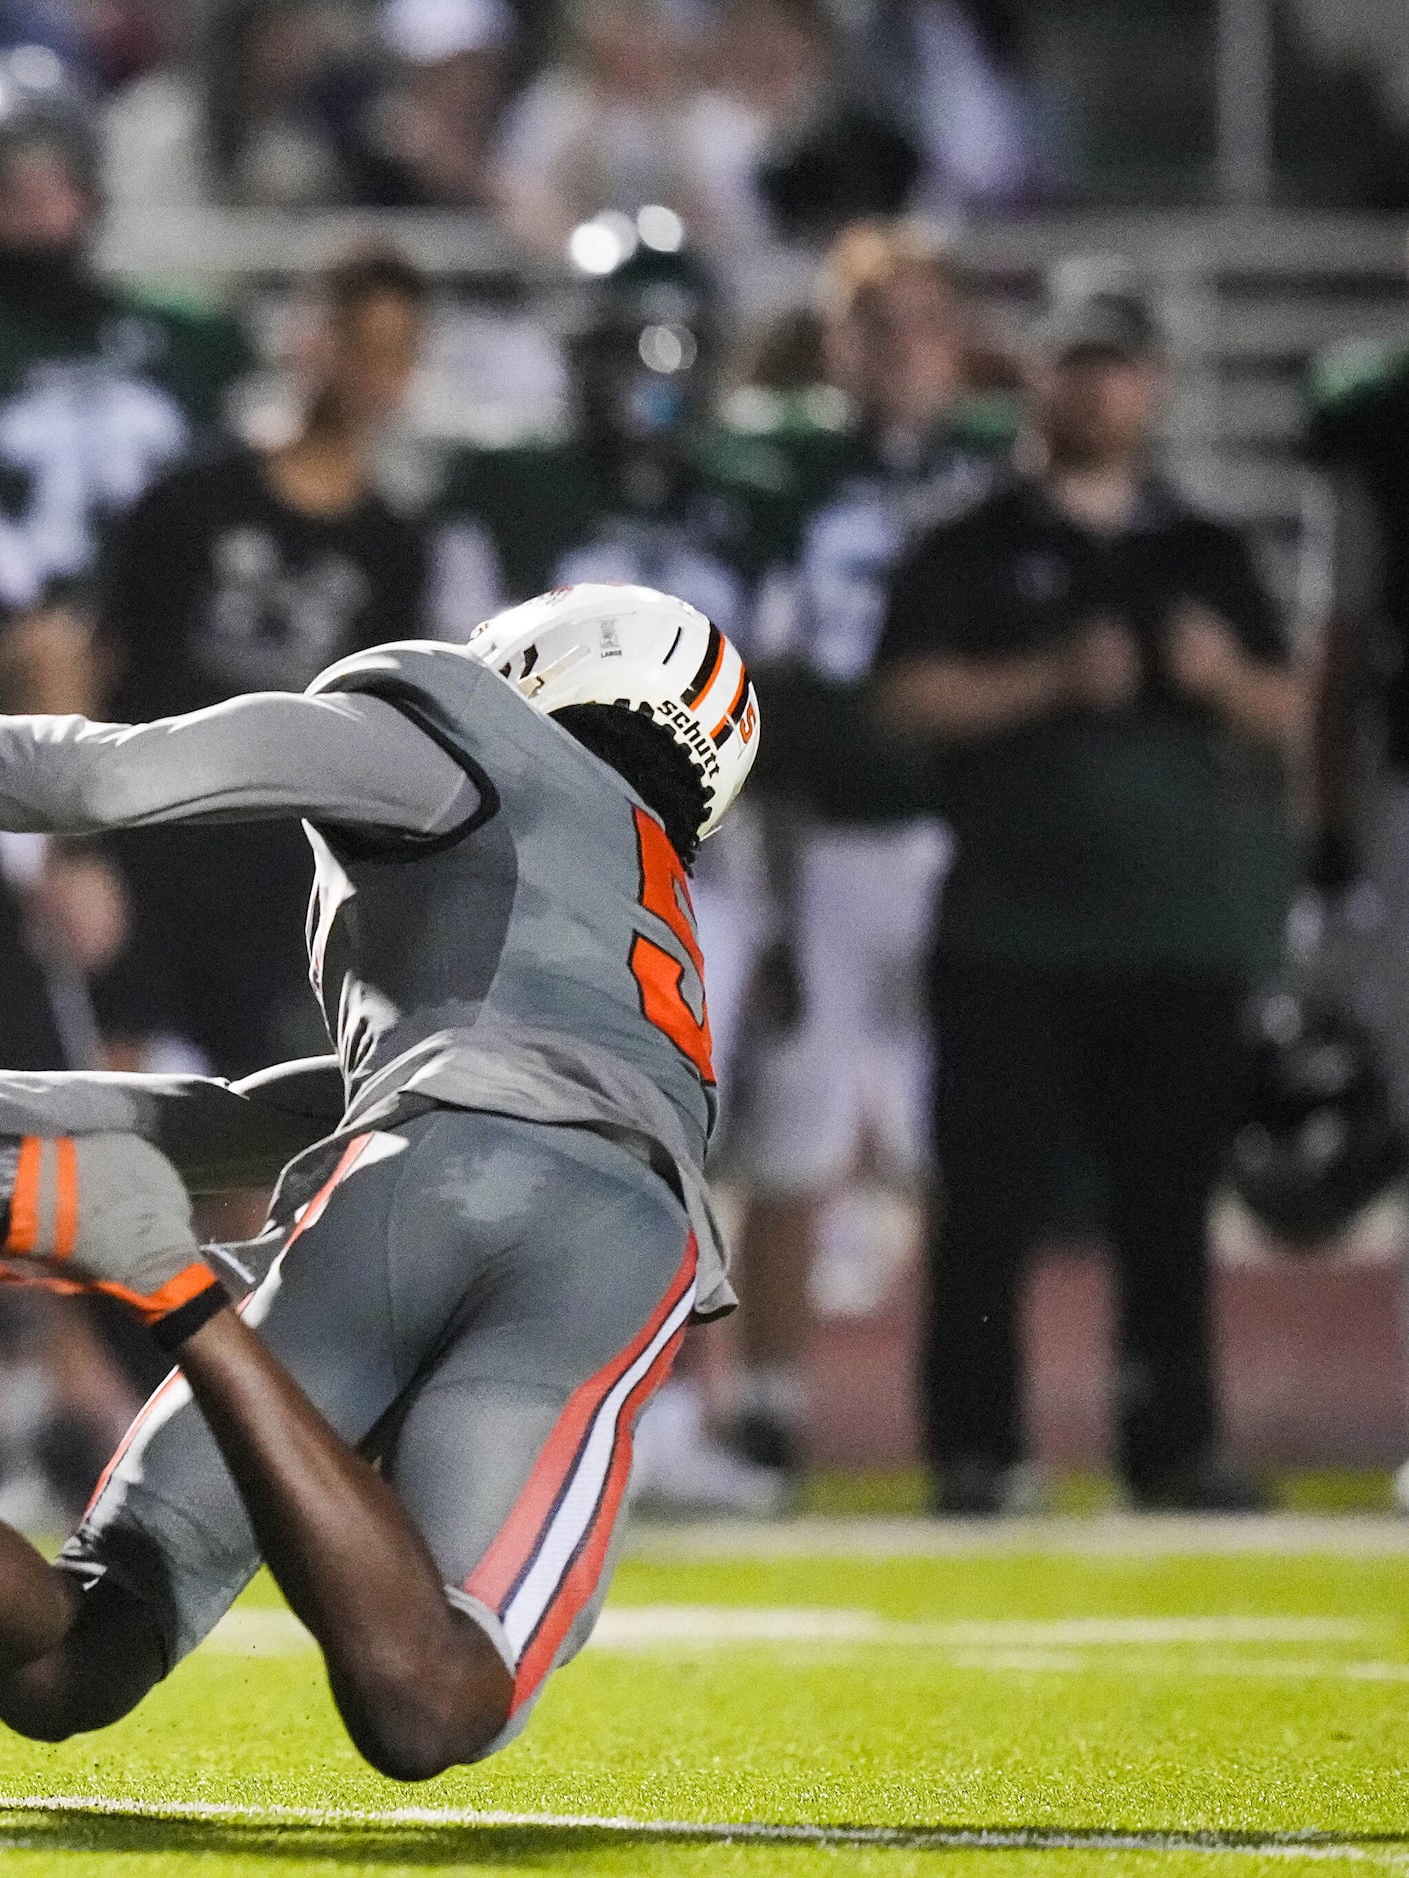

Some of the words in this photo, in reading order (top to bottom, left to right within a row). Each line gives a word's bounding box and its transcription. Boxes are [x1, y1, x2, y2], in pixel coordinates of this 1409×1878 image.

[657, 699, 720, 779] schutt
[739, 701, 756, 744] 5
[627, 802, 717, 1086] 5
